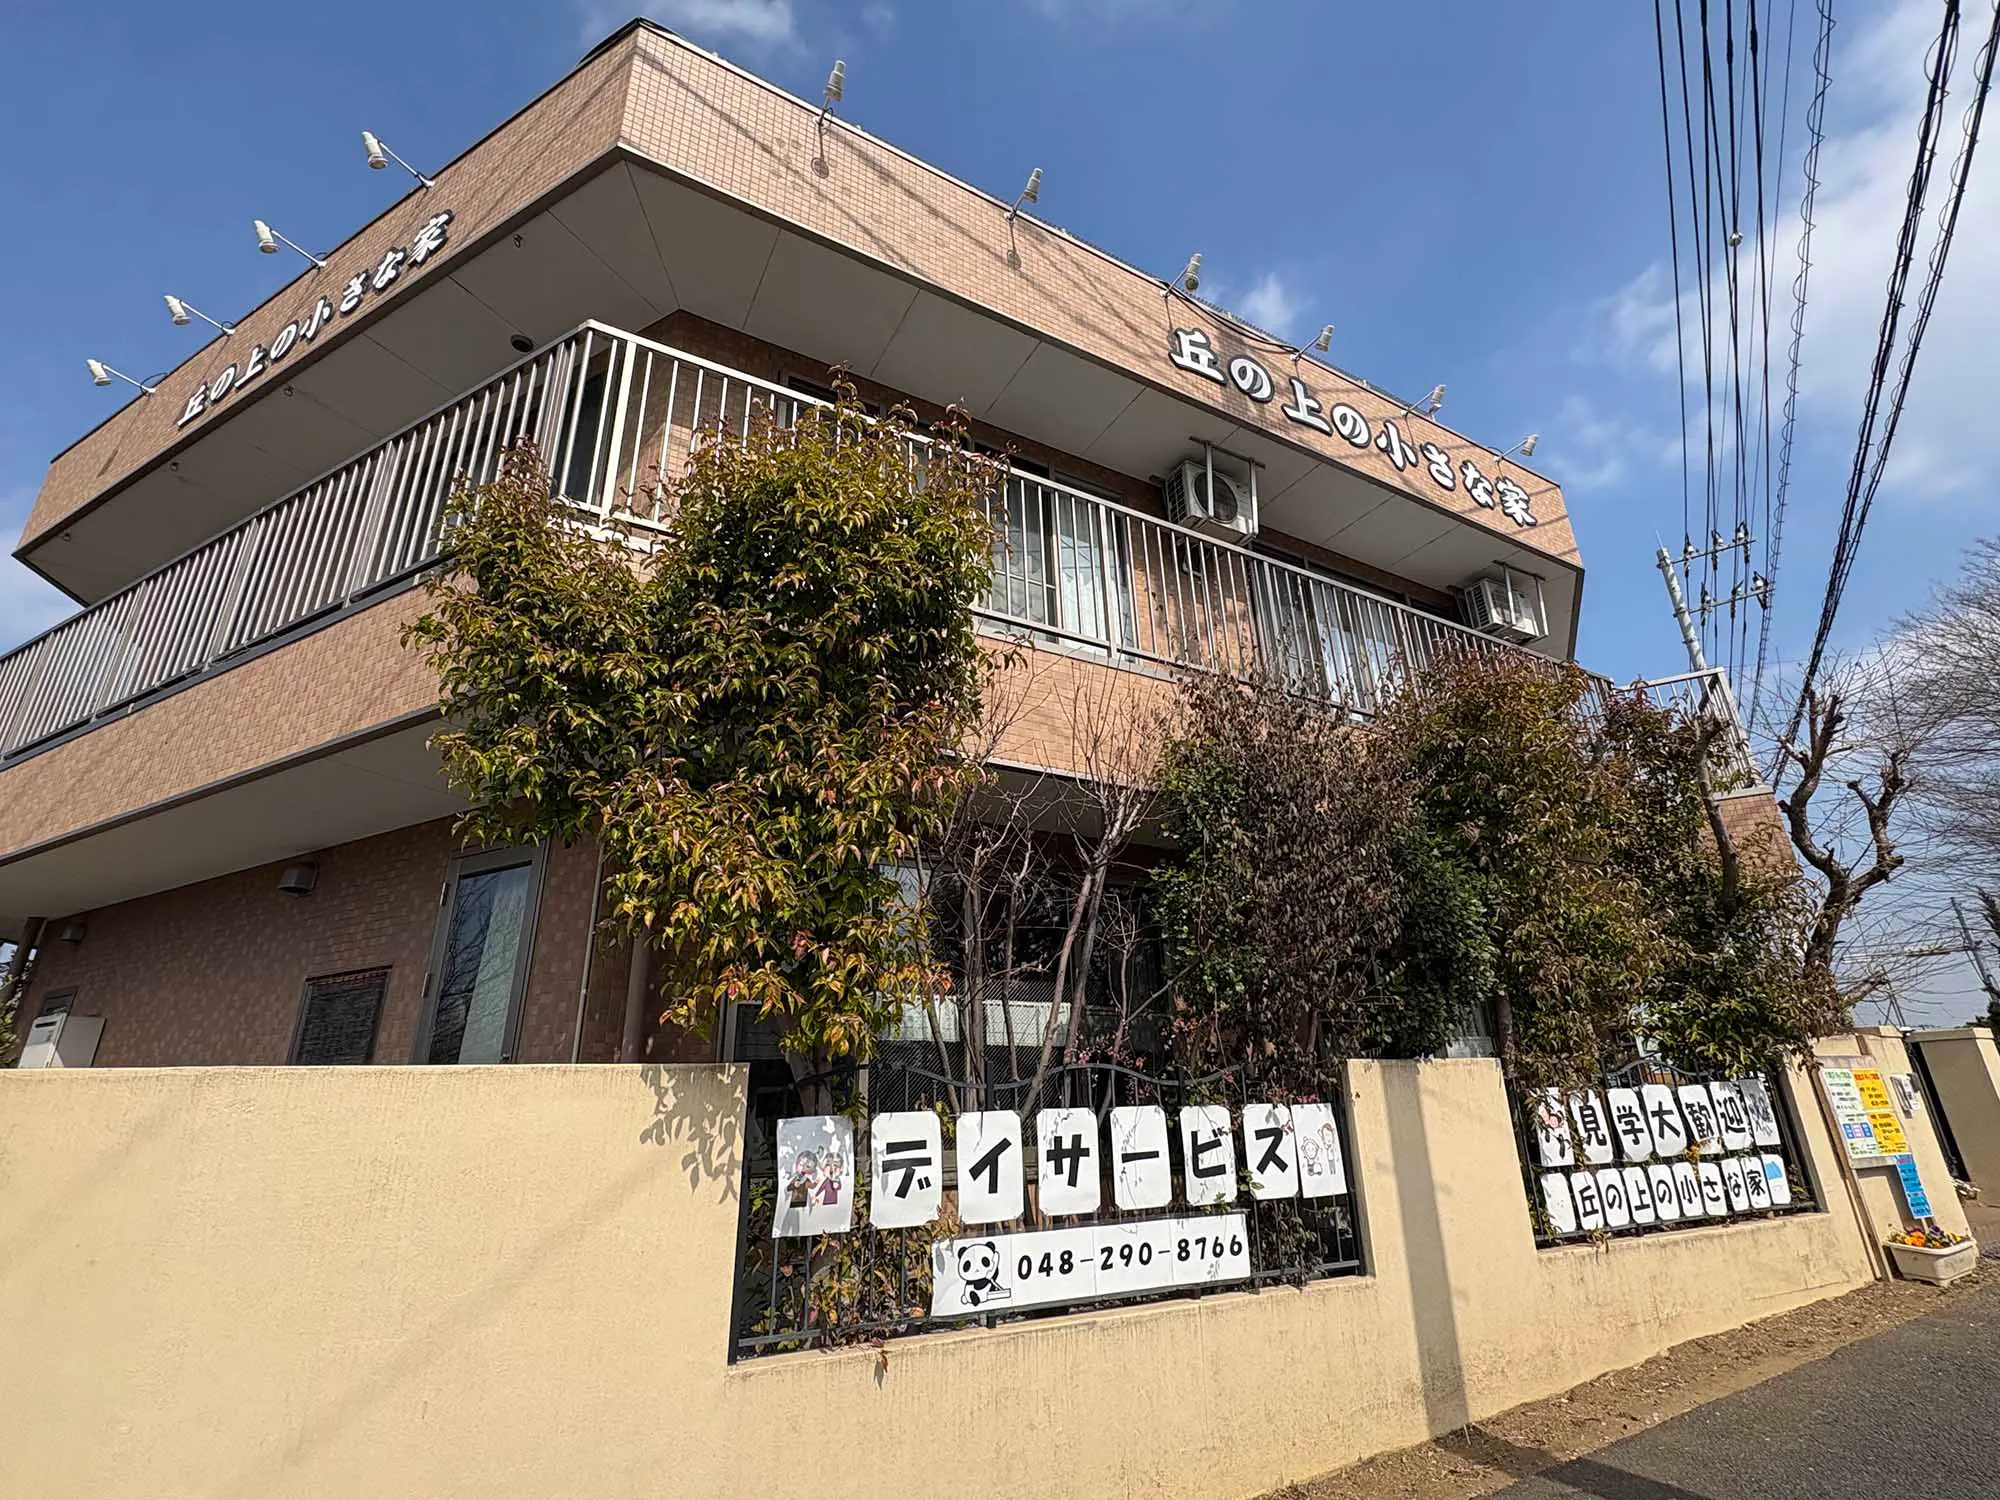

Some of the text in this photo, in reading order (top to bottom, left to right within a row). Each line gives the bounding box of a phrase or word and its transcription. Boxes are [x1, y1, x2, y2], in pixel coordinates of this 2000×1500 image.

[177, 210, 454, 426] 丘の上の小さな家
[1169, 328, 1537, 527] 丘の上の小さな家
[1578, 1101, 1747, 1147] 見学大歓迎
[882, 1134, 1289, 1198] デイサービス
[1578, 1169, 1766, 1218] 丘の上の小さな家
[1017, 1234, 1243, 1280] 048-290-8766
